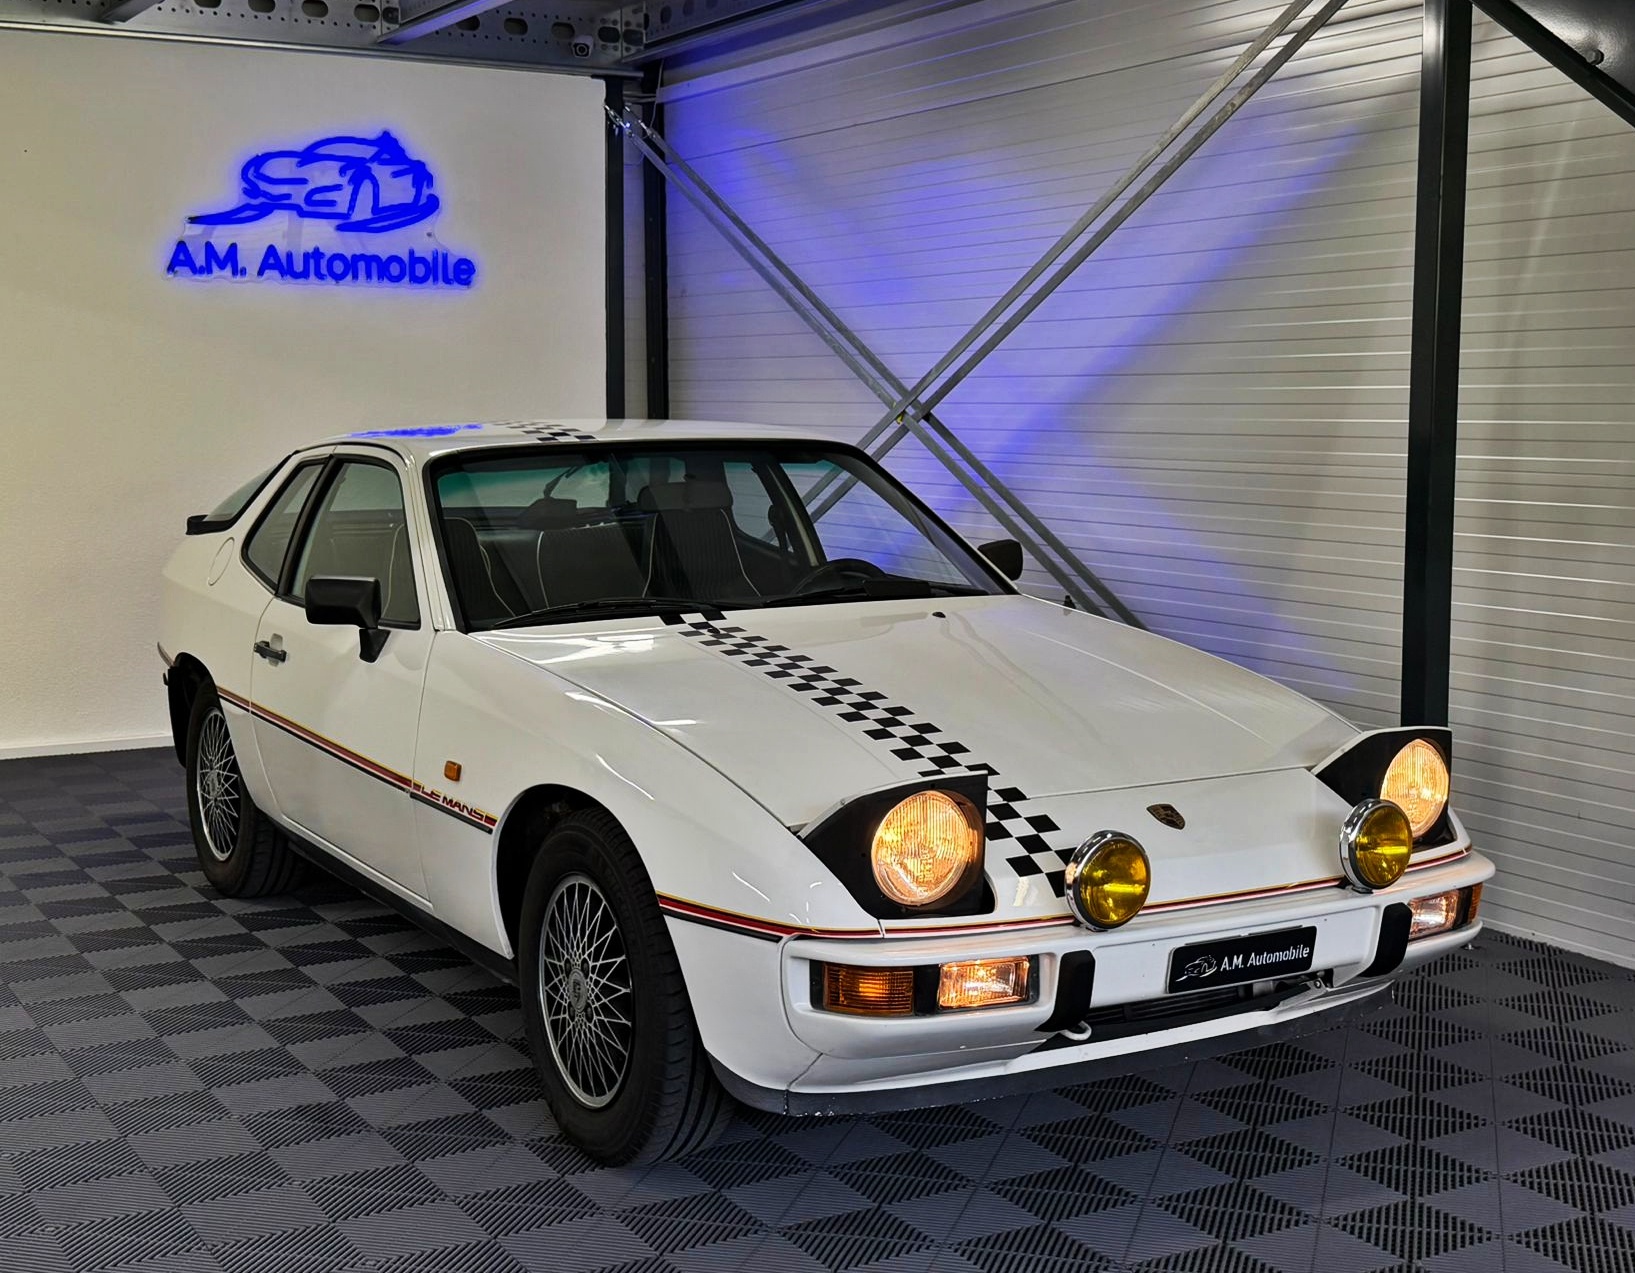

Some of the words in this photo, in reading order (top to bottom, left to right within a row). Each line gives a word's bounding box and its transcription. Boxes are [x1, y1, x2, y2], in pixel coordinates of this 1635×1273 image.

[167, 240, 247, 277] A.M.
[257, 244, 476, 285] Automobile
[421, 785, 441, 801] LE
[442, 796, 484, 821] MANS
[1220, 954, 1244, 972] A.M.
[1247, 944, 1310, 967] Automobile
